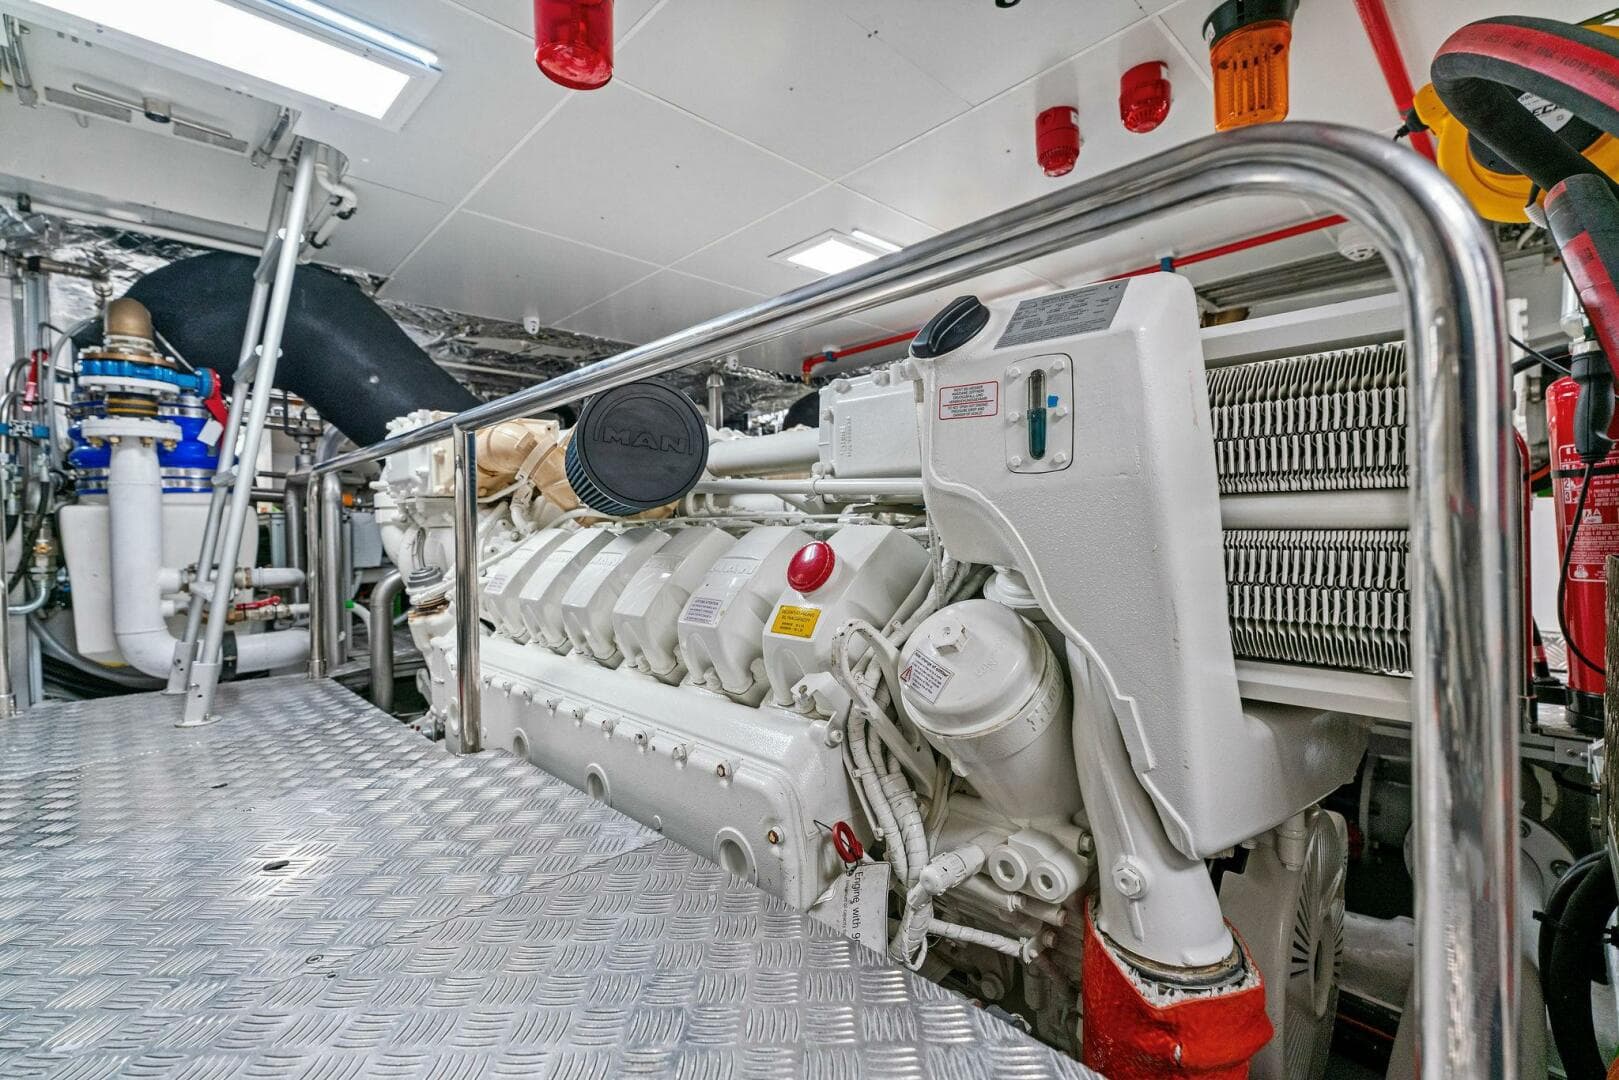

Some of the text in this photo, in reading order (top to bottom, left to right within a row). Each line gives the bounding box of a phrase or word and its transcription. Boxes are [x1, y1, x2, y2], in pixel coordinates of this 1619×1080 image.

[603, 426, 686, 454] MAN
[852, 871, 863, 903] Engine
[853, 907, 861, 928] with
